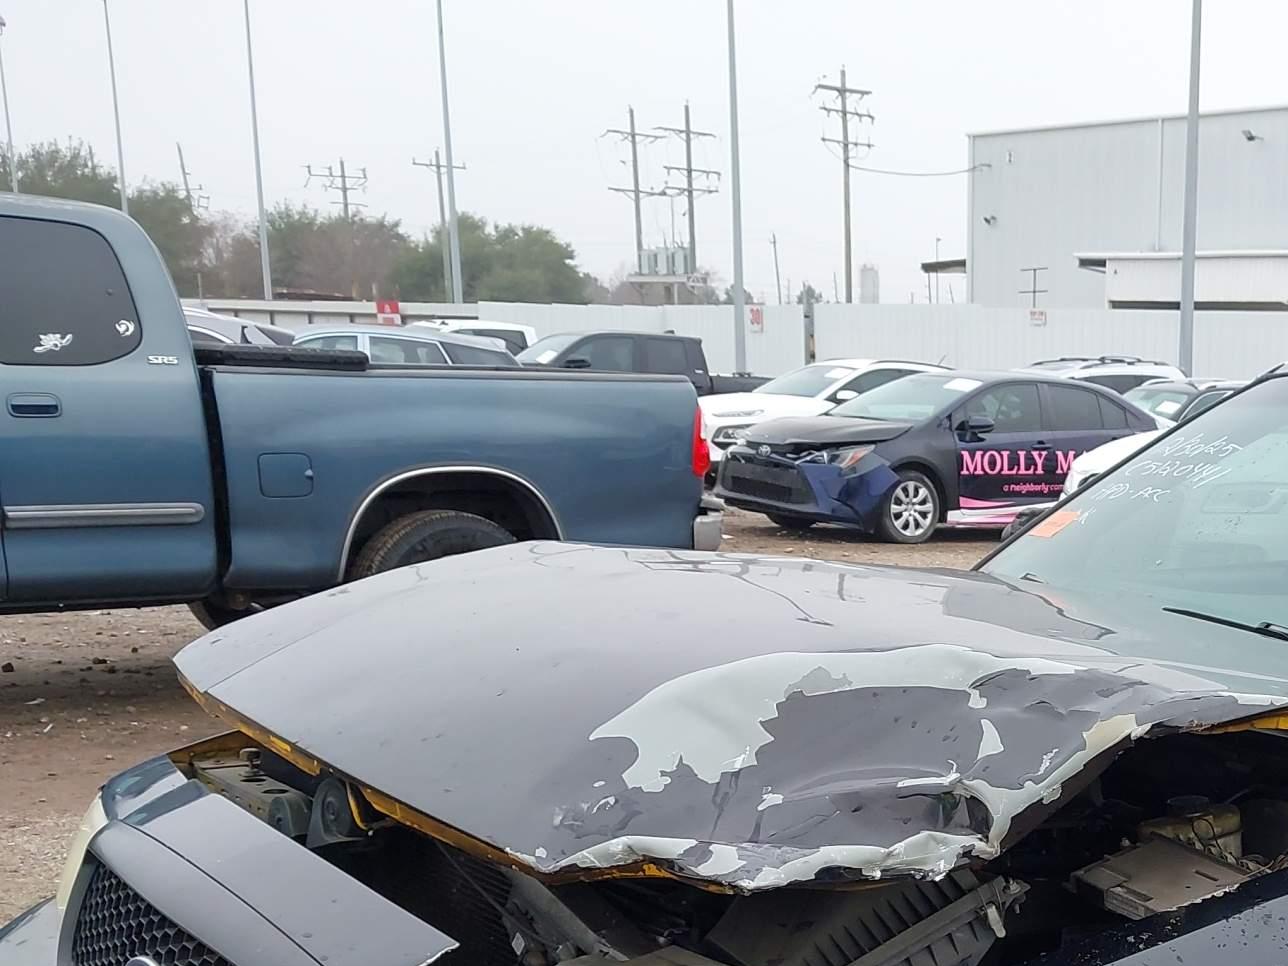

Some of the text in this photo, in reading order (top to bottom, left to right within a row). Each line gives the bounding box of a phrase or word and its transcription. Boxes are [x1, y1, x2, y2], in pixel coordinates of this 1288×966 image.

[960, 450, 1048, 475] MOLLY
[1002, 484, 1010, 492] a
[1009, 482, 1049, 494] neighborly
